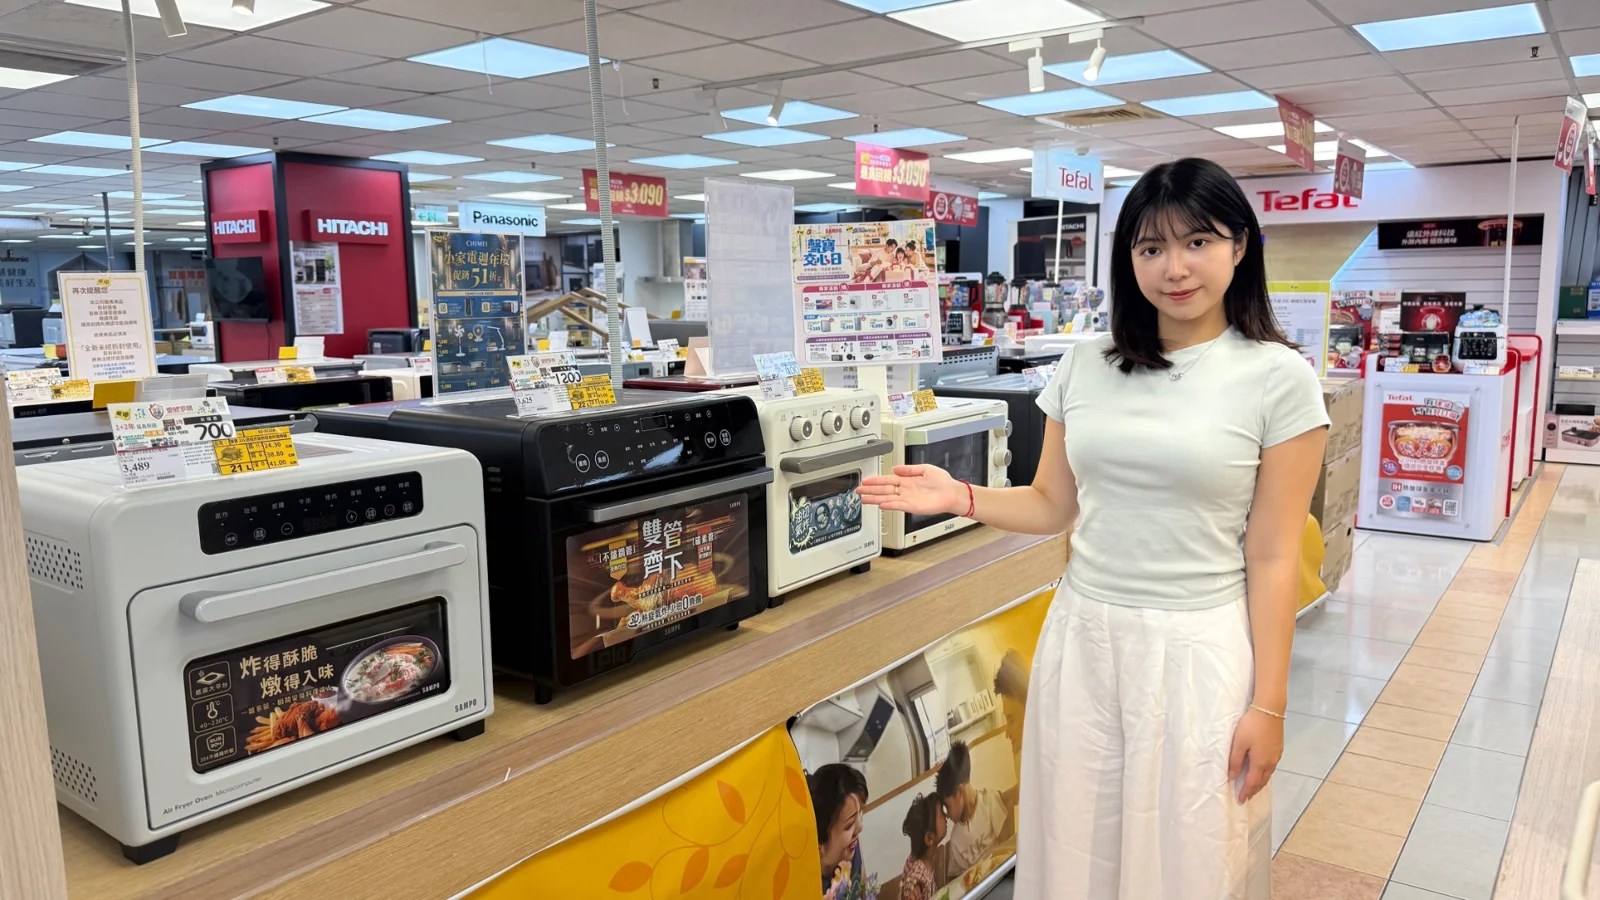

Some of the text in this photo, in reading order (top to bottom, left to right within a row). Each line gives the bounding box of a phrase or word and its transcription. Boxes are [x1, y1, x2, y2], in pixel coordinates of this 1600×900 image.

[1058, 167, 1094, 192] Tefal
[213, 219, 257, 235] HITACHI
[317, 218, 389, 236] HITACHI
[472, 211, 539, 227] Panasonic
[444, 249, 511, 268] 小家電週年慶
[72, 287, 109, 295] 再次提醒您
[193, 422, 234, 441] 700
[122, 461, 150, 473] 3,489
[230, 463, 243, 473] 21
[642, 518, 683, 549] 雙管
[643, 549, 684, 580] 齊下
[239, 644, 318, 680] 炸得酥脆
[260, 663, 335, 699] 燉得入味
[421, 682, 441, 694] SAMPO
[454, 698, 478, 713] SAMPO
[163, 776, 262, 815] Air Fryer Oven Microcomputer
